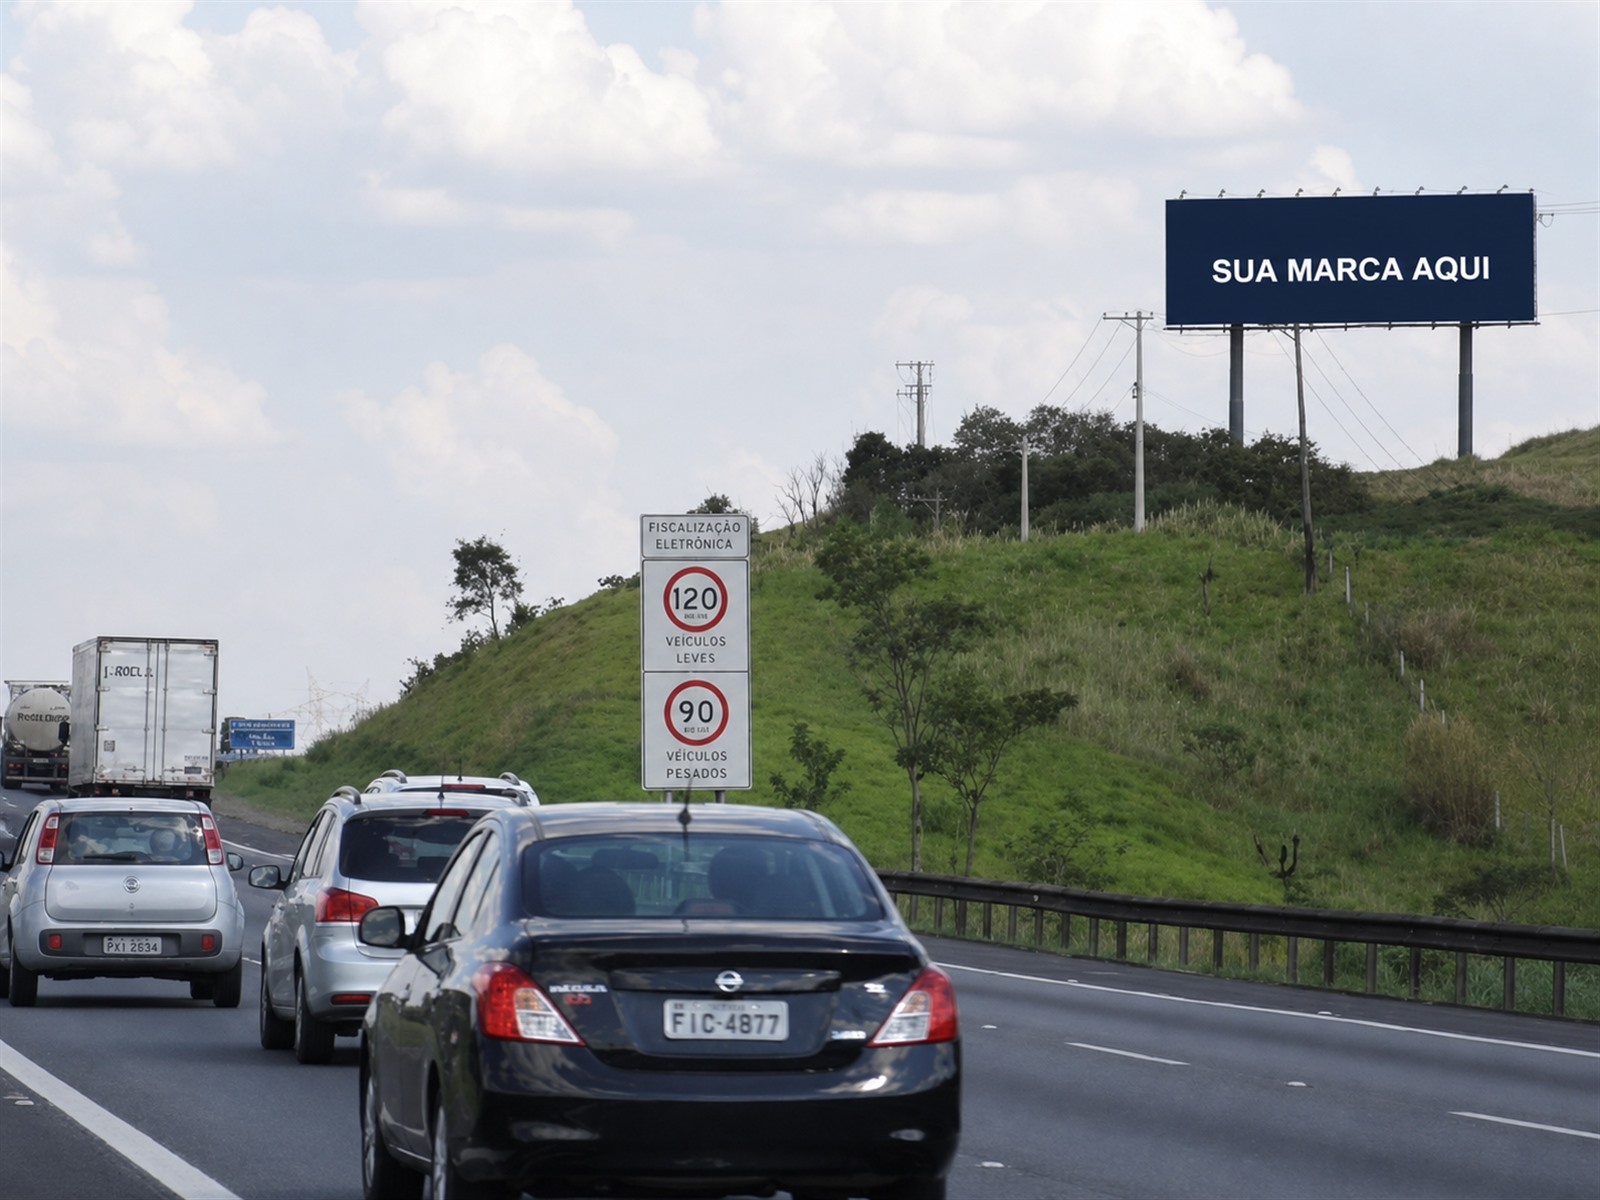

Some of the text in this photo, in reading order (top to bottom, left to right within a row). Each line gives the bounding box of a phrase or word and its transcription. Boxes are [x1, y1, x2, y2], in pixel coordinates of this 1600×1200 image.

[1212, 256, 1490, 283] SUA MARCA AQUI
[648, 520, 741, 536] FISCALIZAÇÃO
[655, 536, 733, 550] ELETRÔNICA
[673, 587, 718, 610] 120
[665, 634, 727, 647] VEÍCULOS
[676, 652, 716, 664] LEVES
[679, 700, 714, 723] 90
[666, 767, 728, 779] PESADOS
[672, 1012, 780, 1035] FIC-4877
